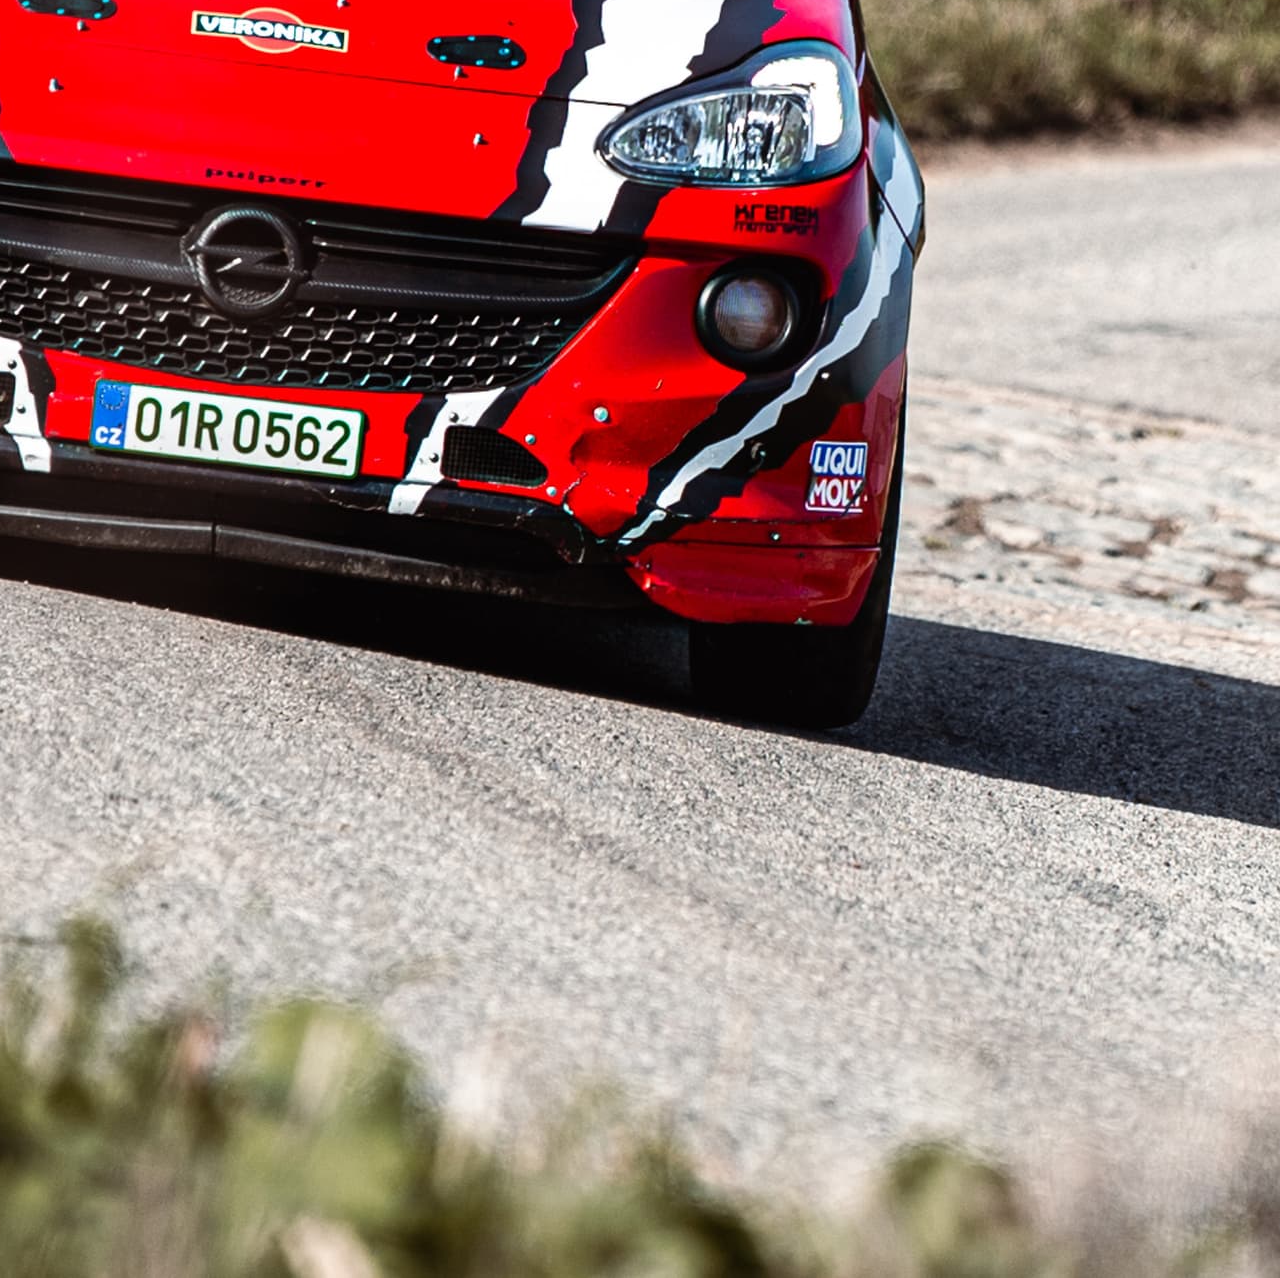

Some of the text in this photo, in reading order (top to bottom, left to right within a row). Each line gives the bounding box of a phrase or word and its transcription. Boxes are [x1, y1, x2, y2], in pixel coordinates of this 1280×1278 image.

[200, 15, 344, 49] VERONIKA
[95, 426, 122, 446] CZ
[134, 396, 351, 466] 01R 0562
[813, 446, 864, 475] LIQUI
[809, 477, 863, 508] MOLY
